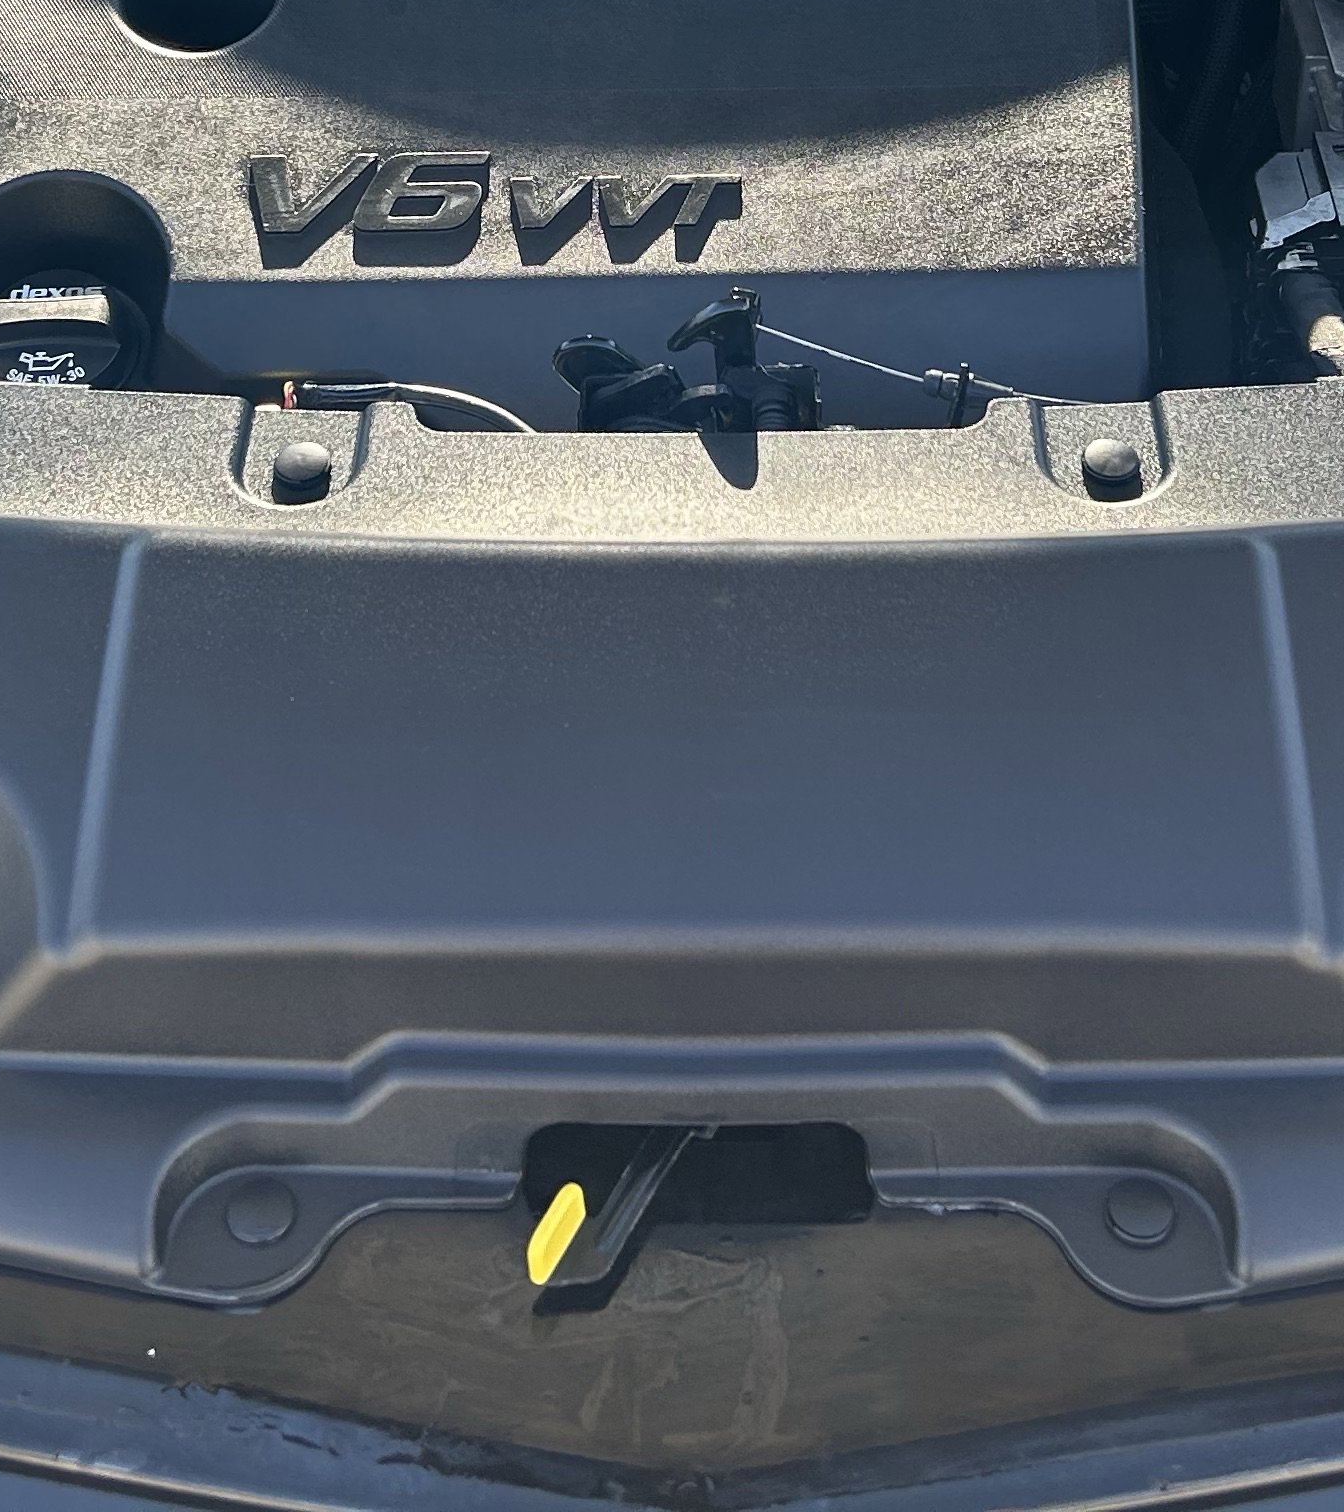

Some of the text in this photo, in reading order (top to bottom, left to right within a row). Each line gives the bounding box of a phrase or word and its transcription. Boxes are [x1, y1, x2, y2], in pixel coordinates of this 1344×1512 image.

[249, 151, 743, 240] V6 VVT
[38, 366, 86, 385] 5W-30
